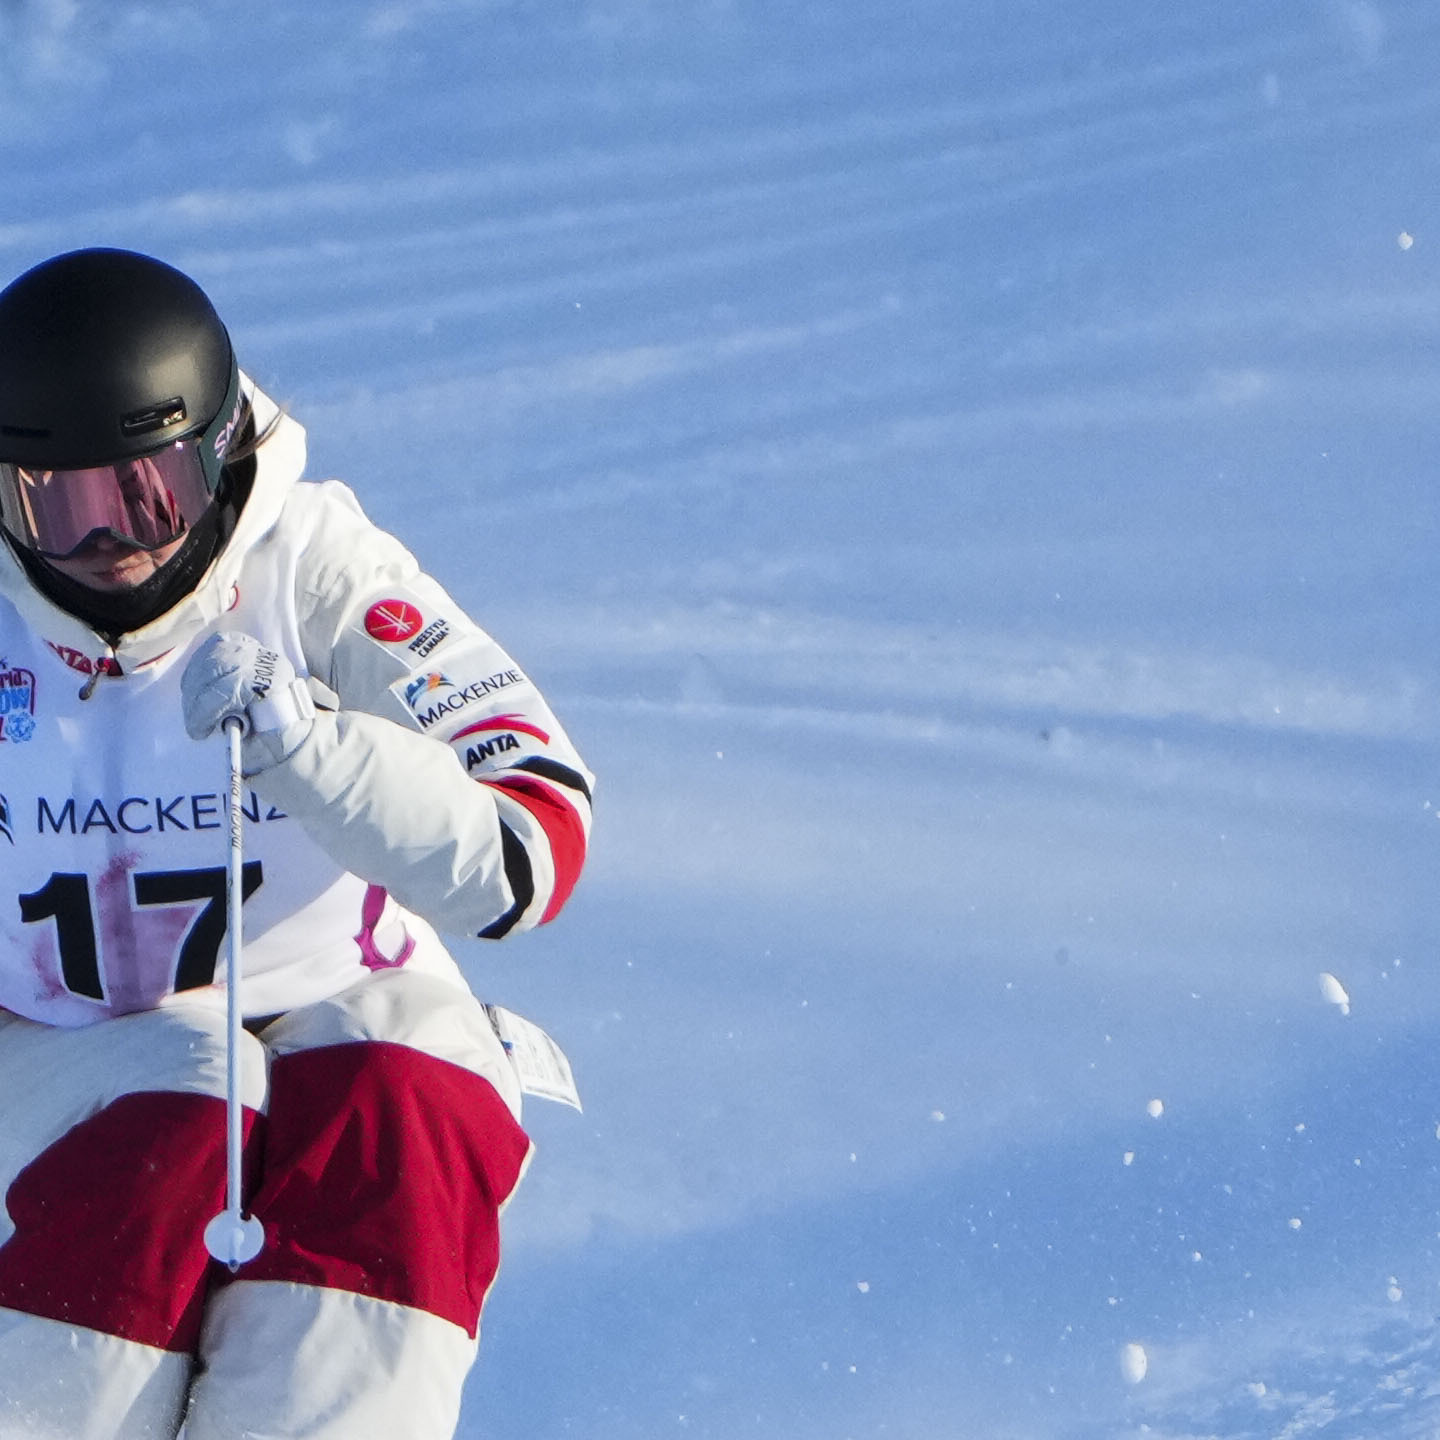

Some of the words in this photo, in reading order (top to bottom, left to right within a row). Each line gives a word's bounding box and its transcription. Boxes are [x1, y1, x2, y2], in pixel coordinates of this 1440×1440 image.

[418, 628, 448, 658] CANADA
[416, 669, 524, 728] MACKENZIE
[466, 733, 520, 772] ANTA
[19, 860, 264, 1001] 17
